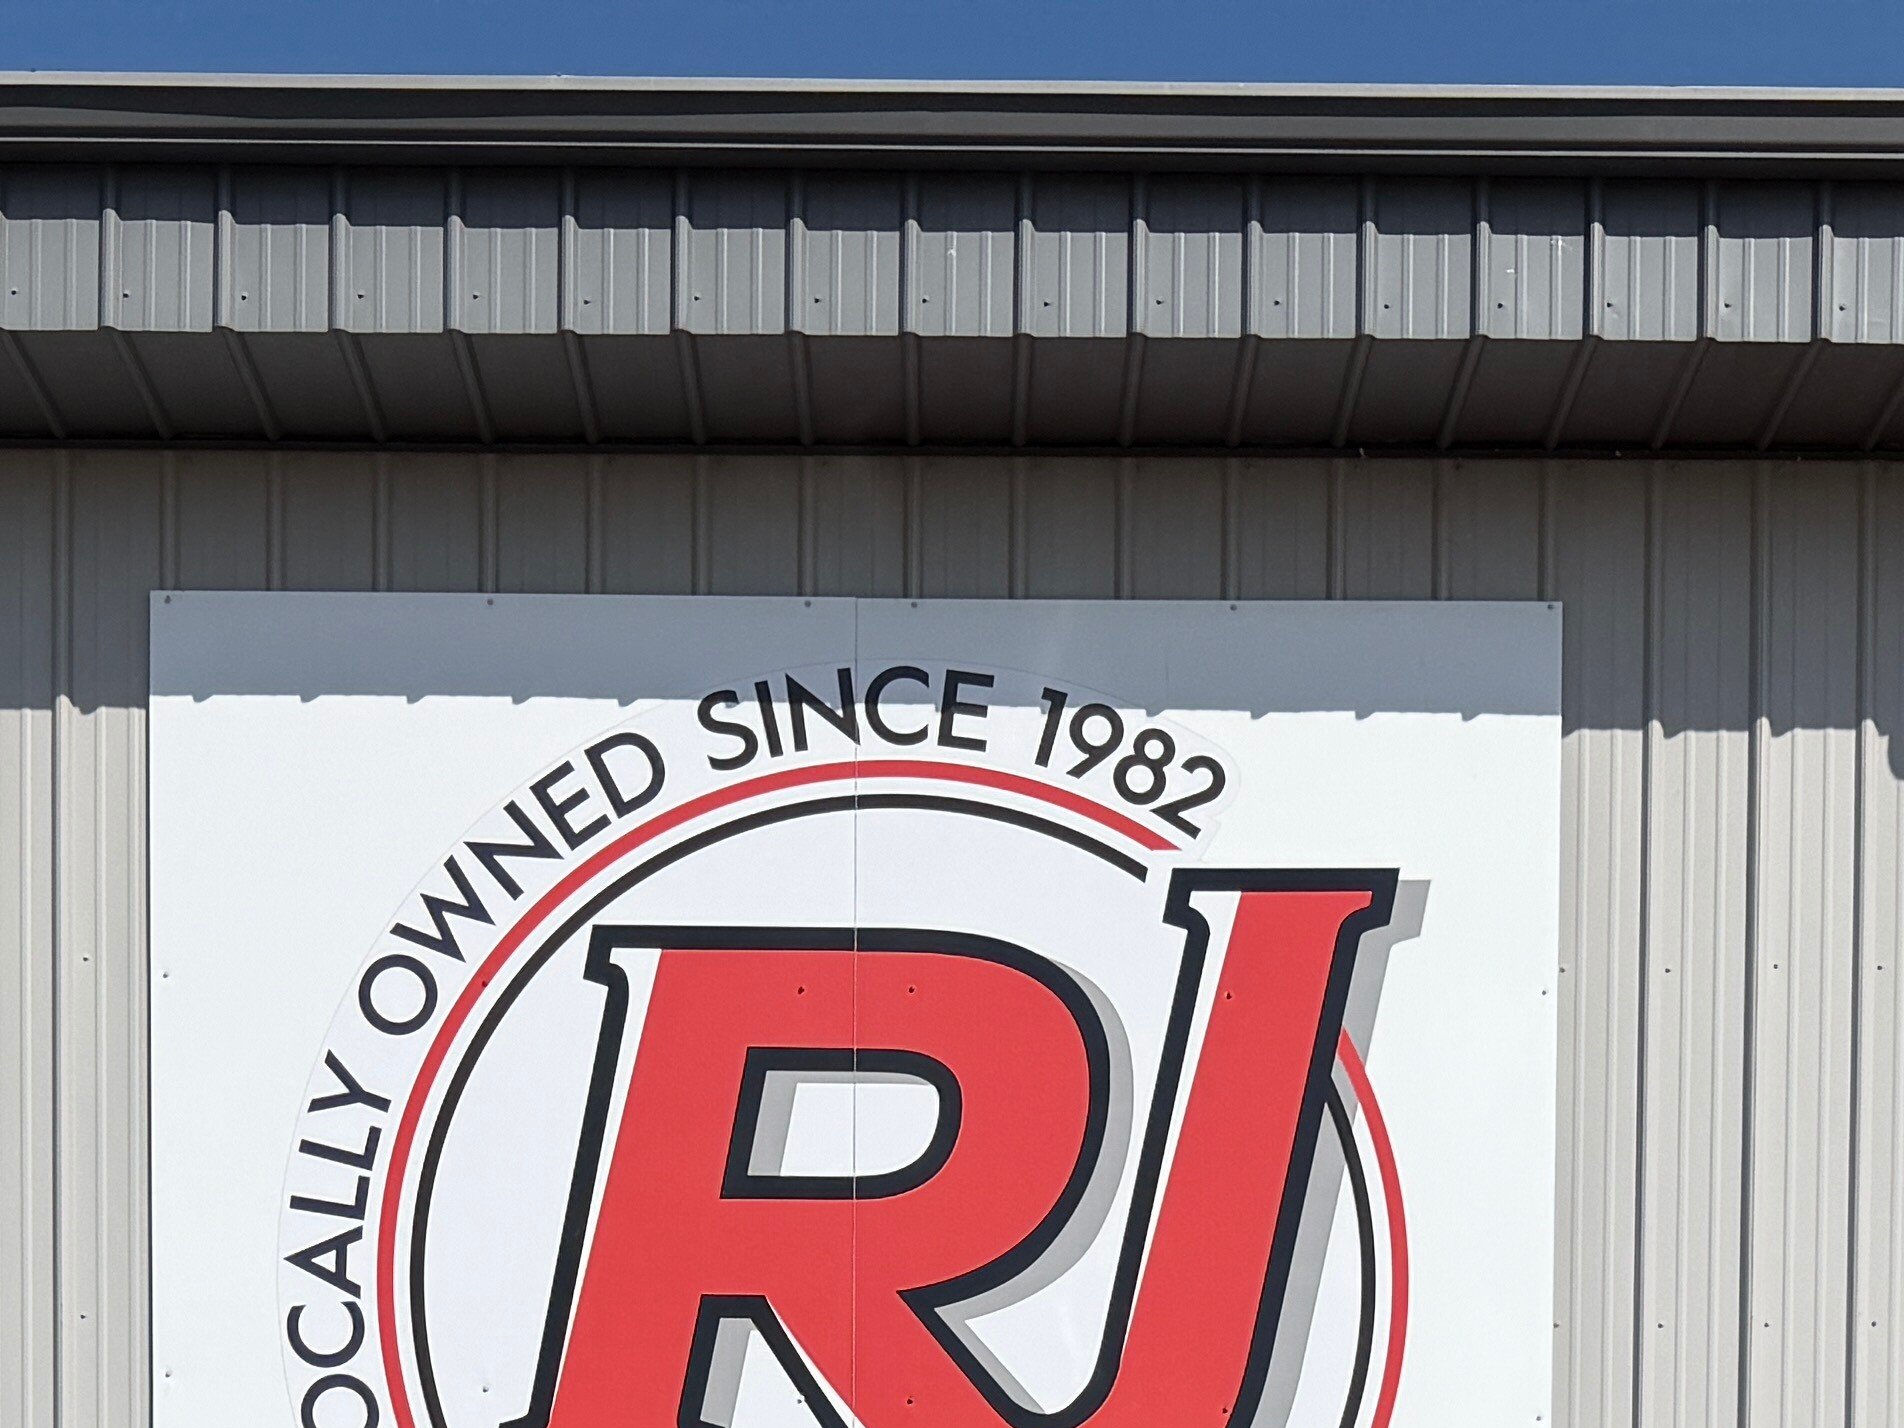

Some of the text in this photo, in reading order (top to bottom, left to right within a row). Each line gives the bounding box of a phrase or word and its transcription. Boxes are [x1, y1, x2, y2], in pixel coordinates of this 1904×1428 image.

[357, 731, 667, 1037] OWNED
[696, 664, 996, 772] SINCE
[1033, 685, 1227, 841] 1982
